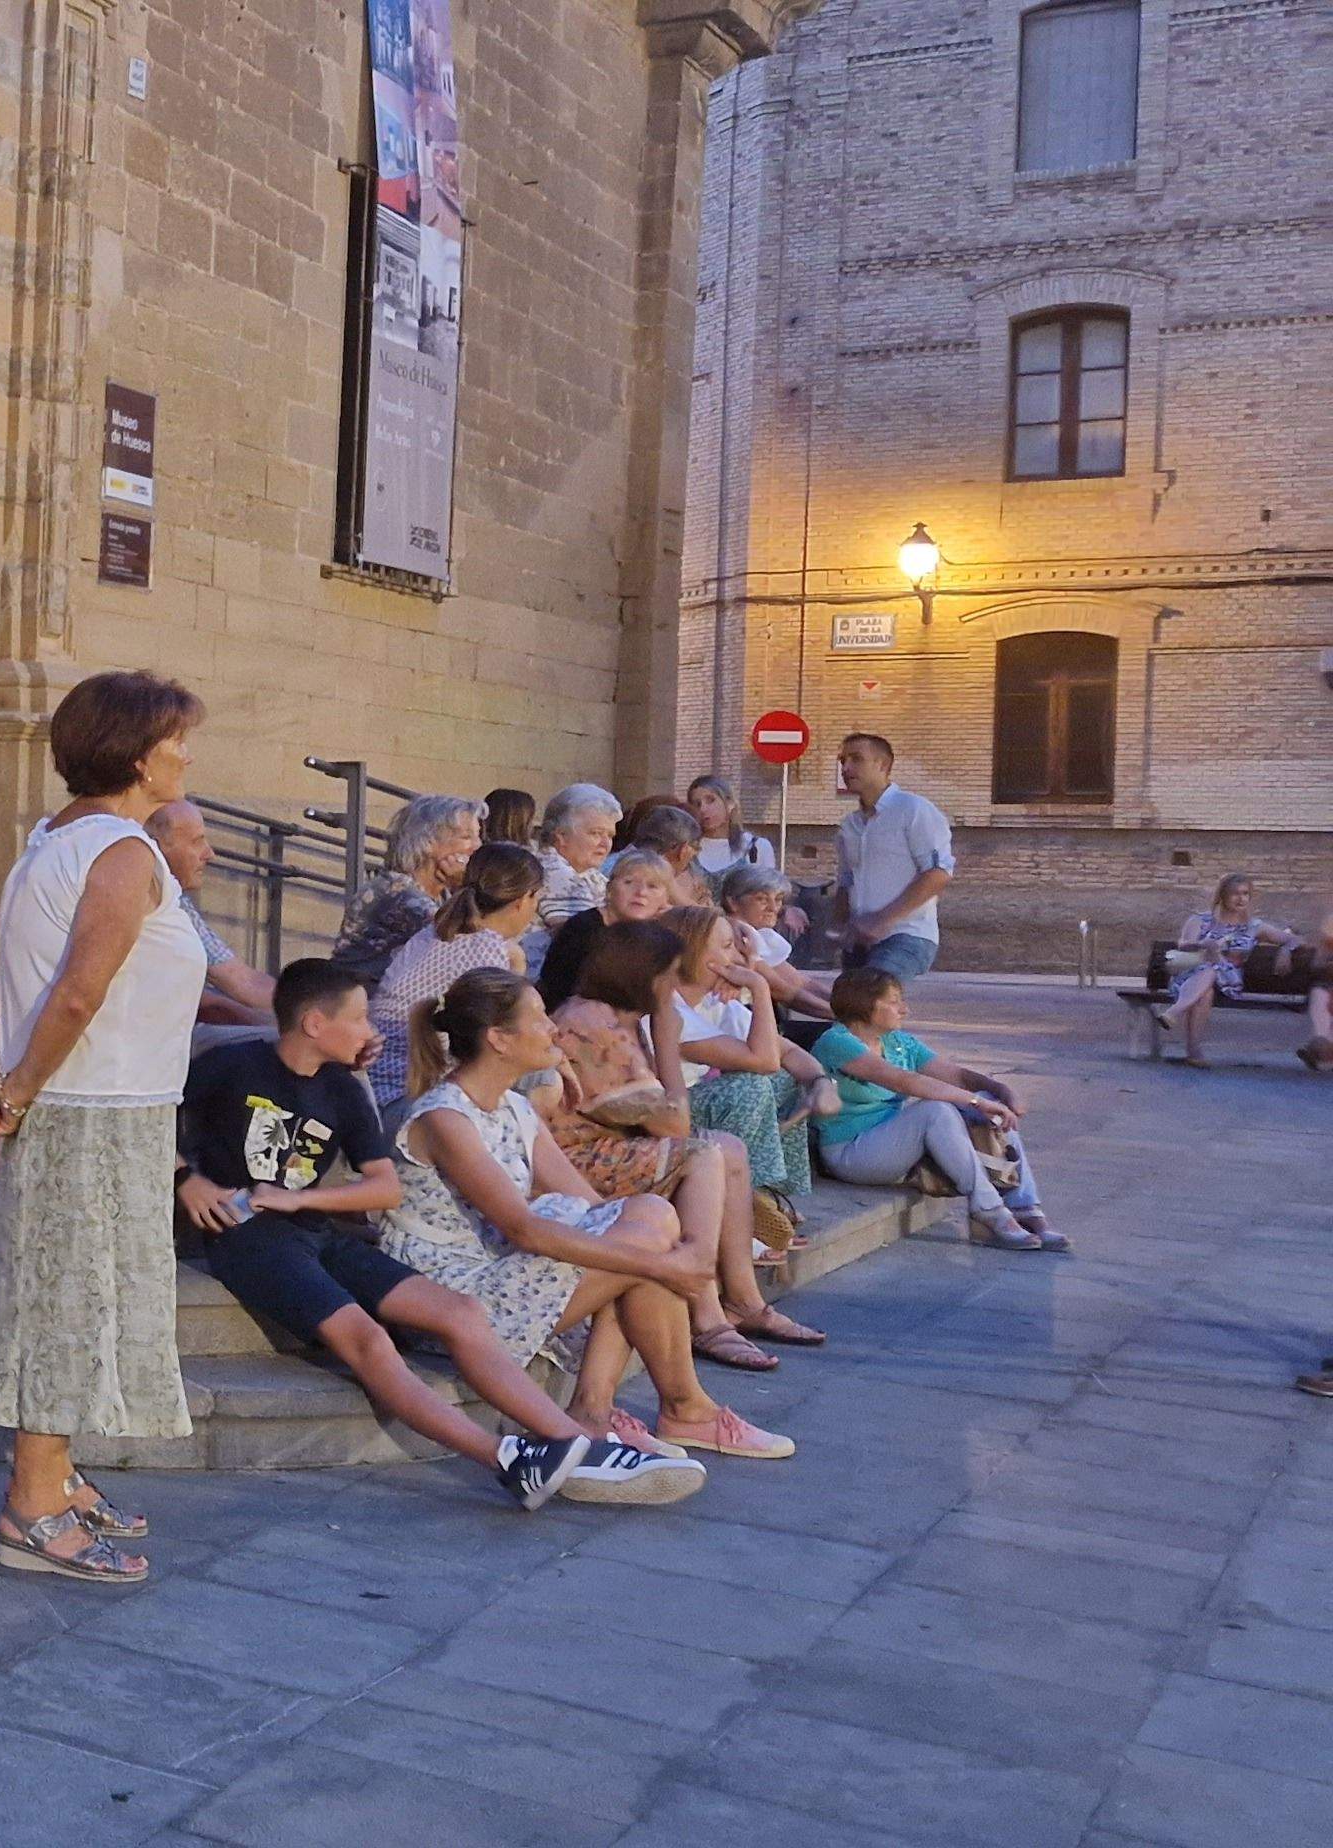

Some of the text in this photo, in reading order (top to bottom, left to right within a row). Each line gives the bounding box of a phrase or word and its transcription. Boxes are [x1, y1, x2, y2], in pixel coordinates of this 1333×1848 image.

[111, 408, 139, 431] Museo
[110, 429, 151, 454] de Huesca
[836, 635, 892, 644] UNIVERSIDAD
